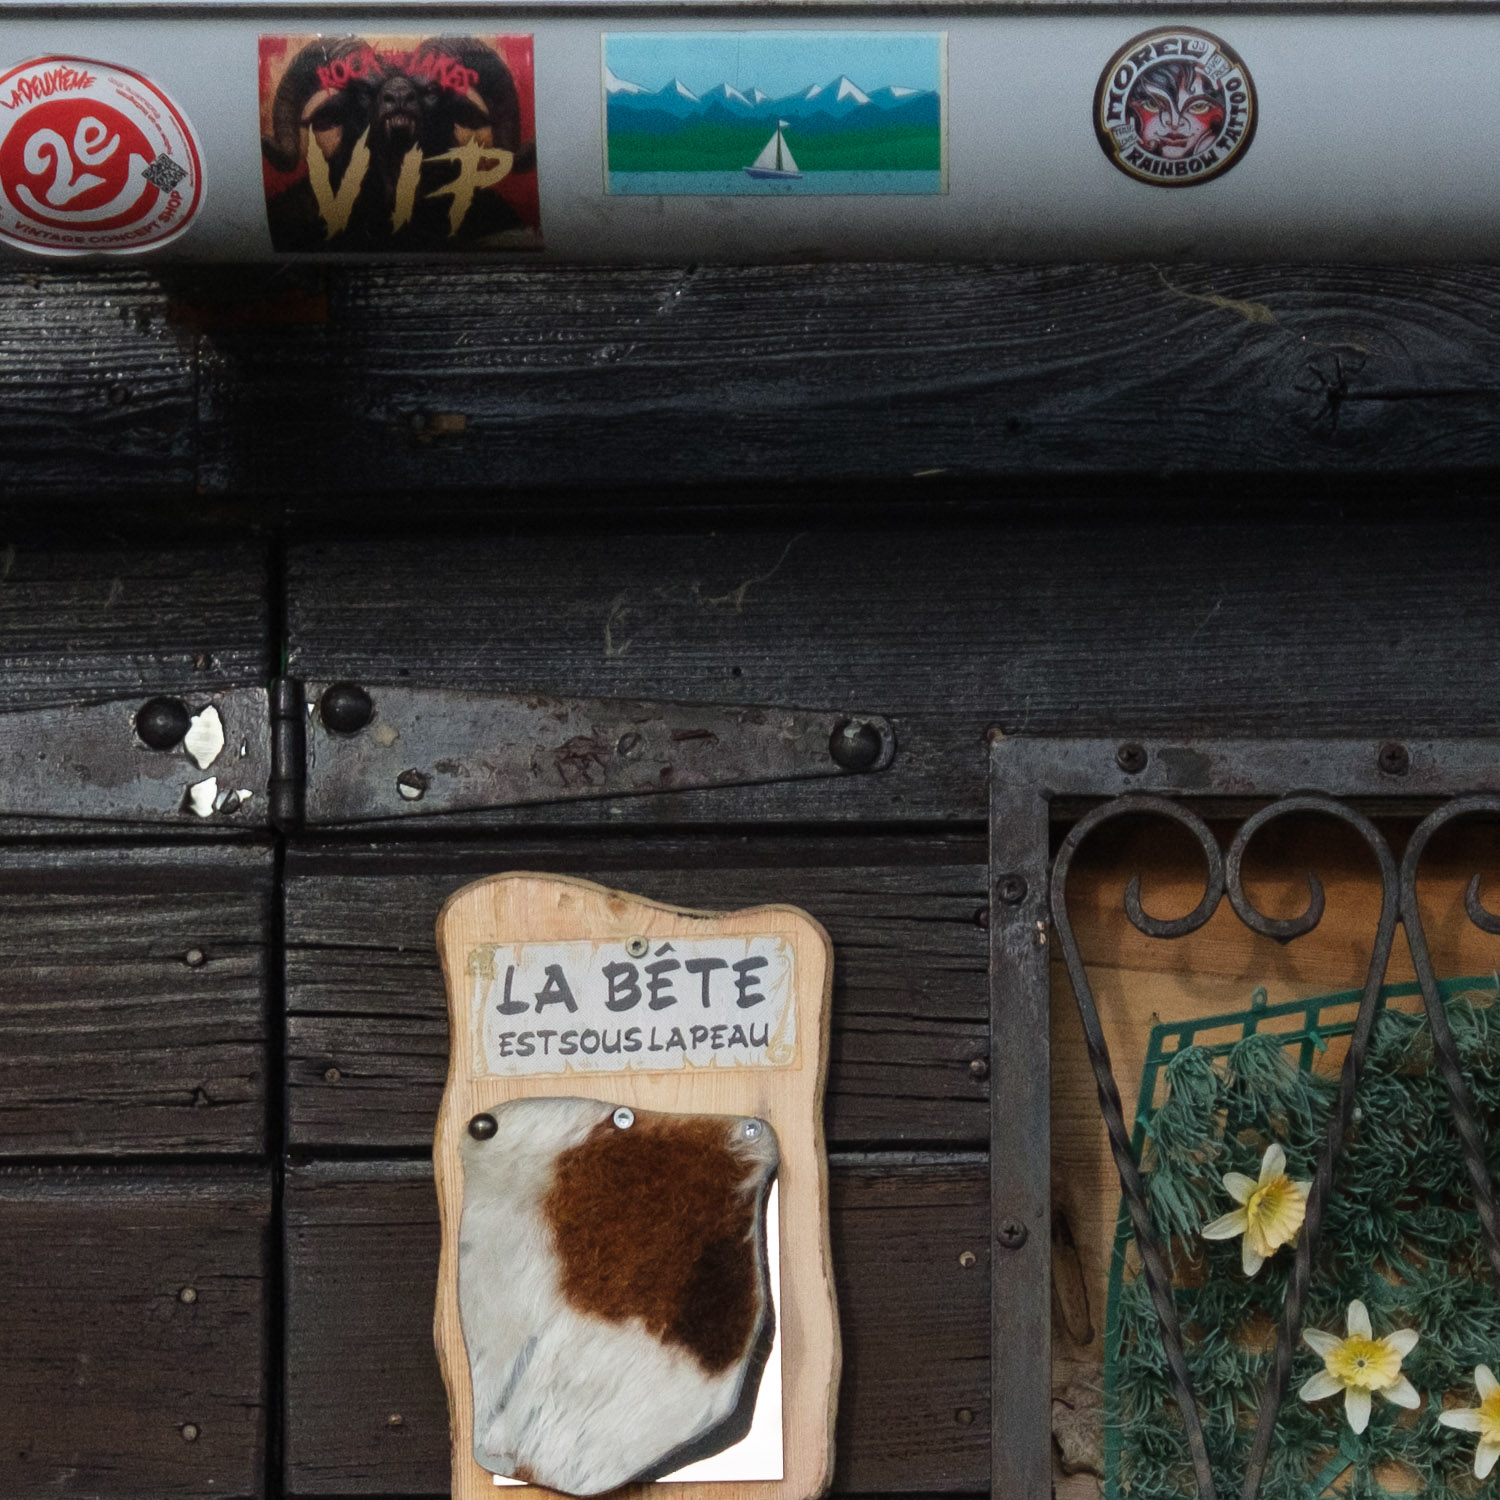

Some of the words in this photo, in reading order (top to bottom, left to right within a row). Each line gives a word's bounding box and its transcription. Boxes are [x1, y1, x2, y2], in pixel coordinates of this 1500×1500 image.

[1124, 148, 1221, 177] RAINBOW
[1215, 77, 1247, 151] TATTOO
[14, 220, 86, 244] VINTAGE
[88, 221, 162, 244] CONCEPT
[158, 190, 184, 224] SHOP
[307, 123, 514, 240] VIP
[496, 964, 579, 1016] LA
[602, 942, 769, 1013] BÊTE
